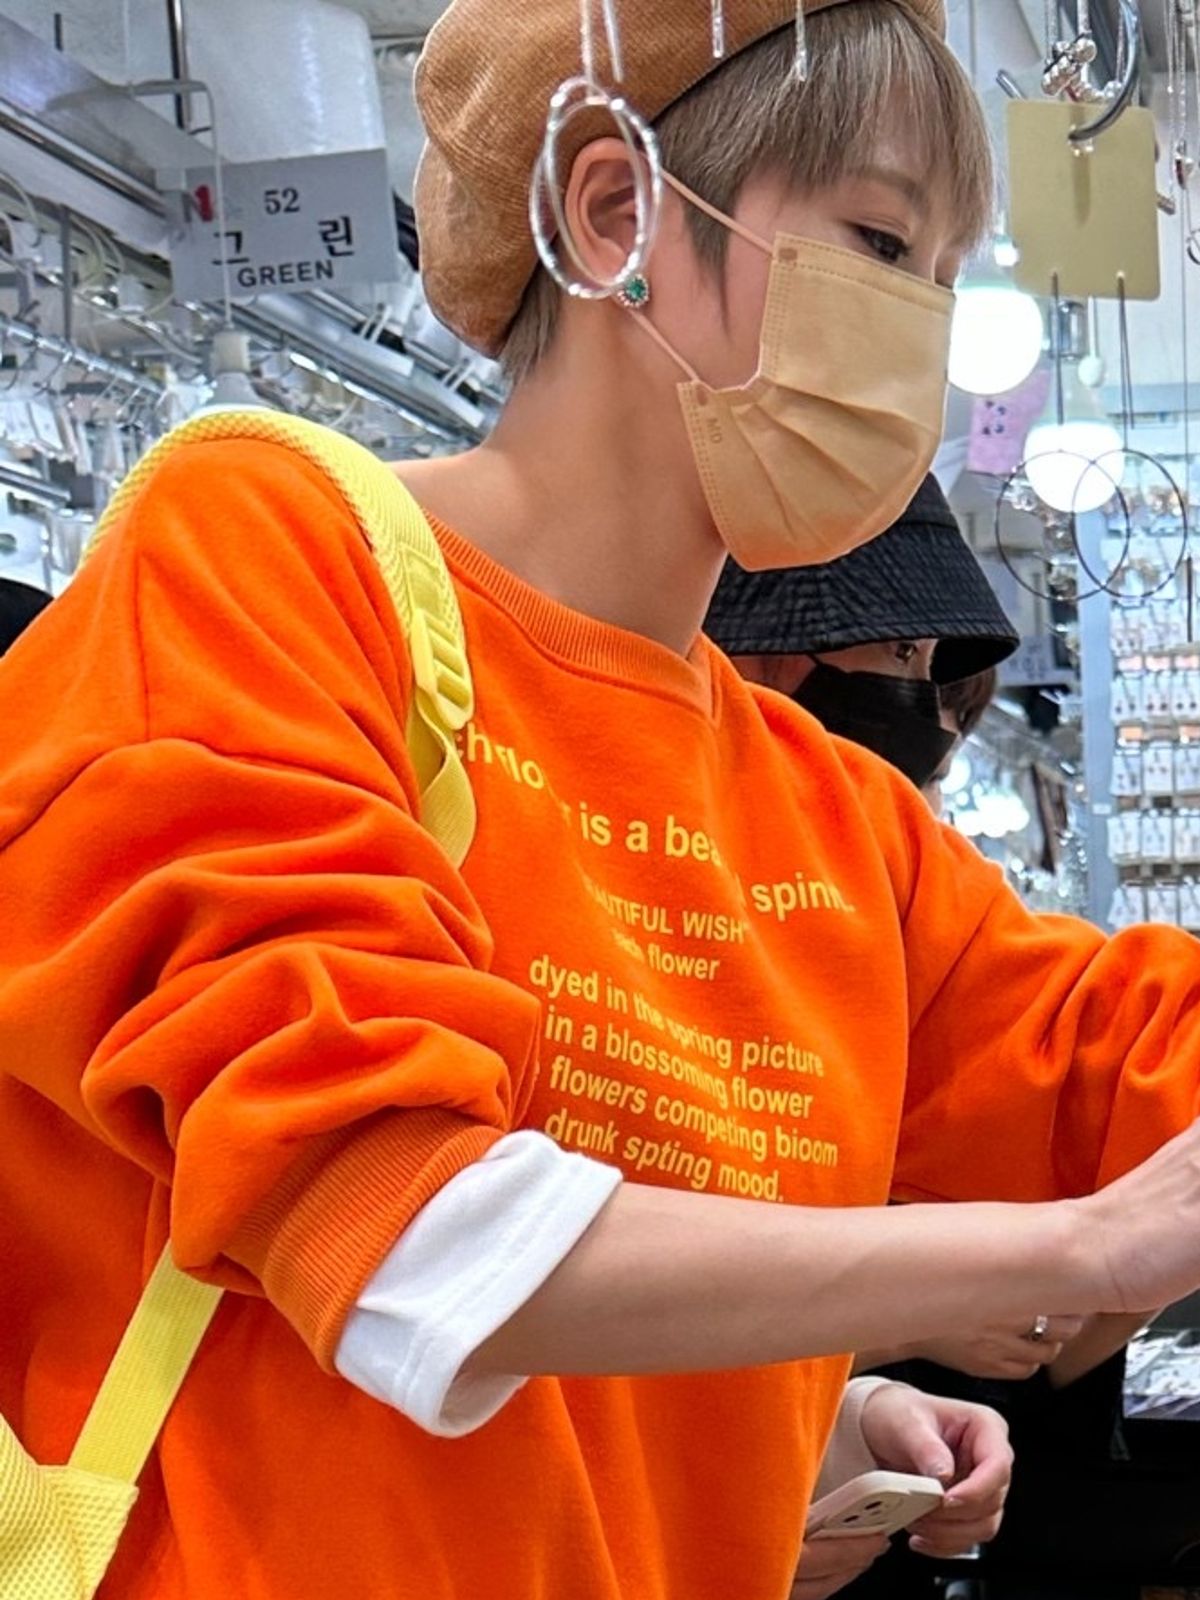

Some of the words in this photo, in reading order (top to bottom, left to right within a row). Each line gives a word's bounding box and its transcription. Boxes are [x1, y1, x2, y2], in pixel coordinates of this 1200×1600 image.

[264, 188, 300, 214] 52
[212, 230, 249, 265] 그
[318, 216, 354, 257] 린
[237, 260, 334, 288] GREEN
[579, 801, 611, 845] is
[625, 821, 649, 853] a
[648, 942, 720, 981] flower
[529, 954, 599, 1003] dyed
[606, 977, 628, 1013] in
[633, 992, 665, 1030] the
[666, 1017, 733, 1068] spring
[741, 1035, 824, 1077] picture
[545, 1005, 573, 1044] in
[581, 1024, 598, 1052] a
[605, 1022, 729, 1110] blossoming
[731, 1075, 814, 1119] flower
[550, 1055, 647, 1115] flowers
[654, 1094, 768, 1163] competing
[545, 1108, 619, 1155] drunk
[622, 1135, 712, 1190] spting
[717, 1163, 785, 1203] mood.
